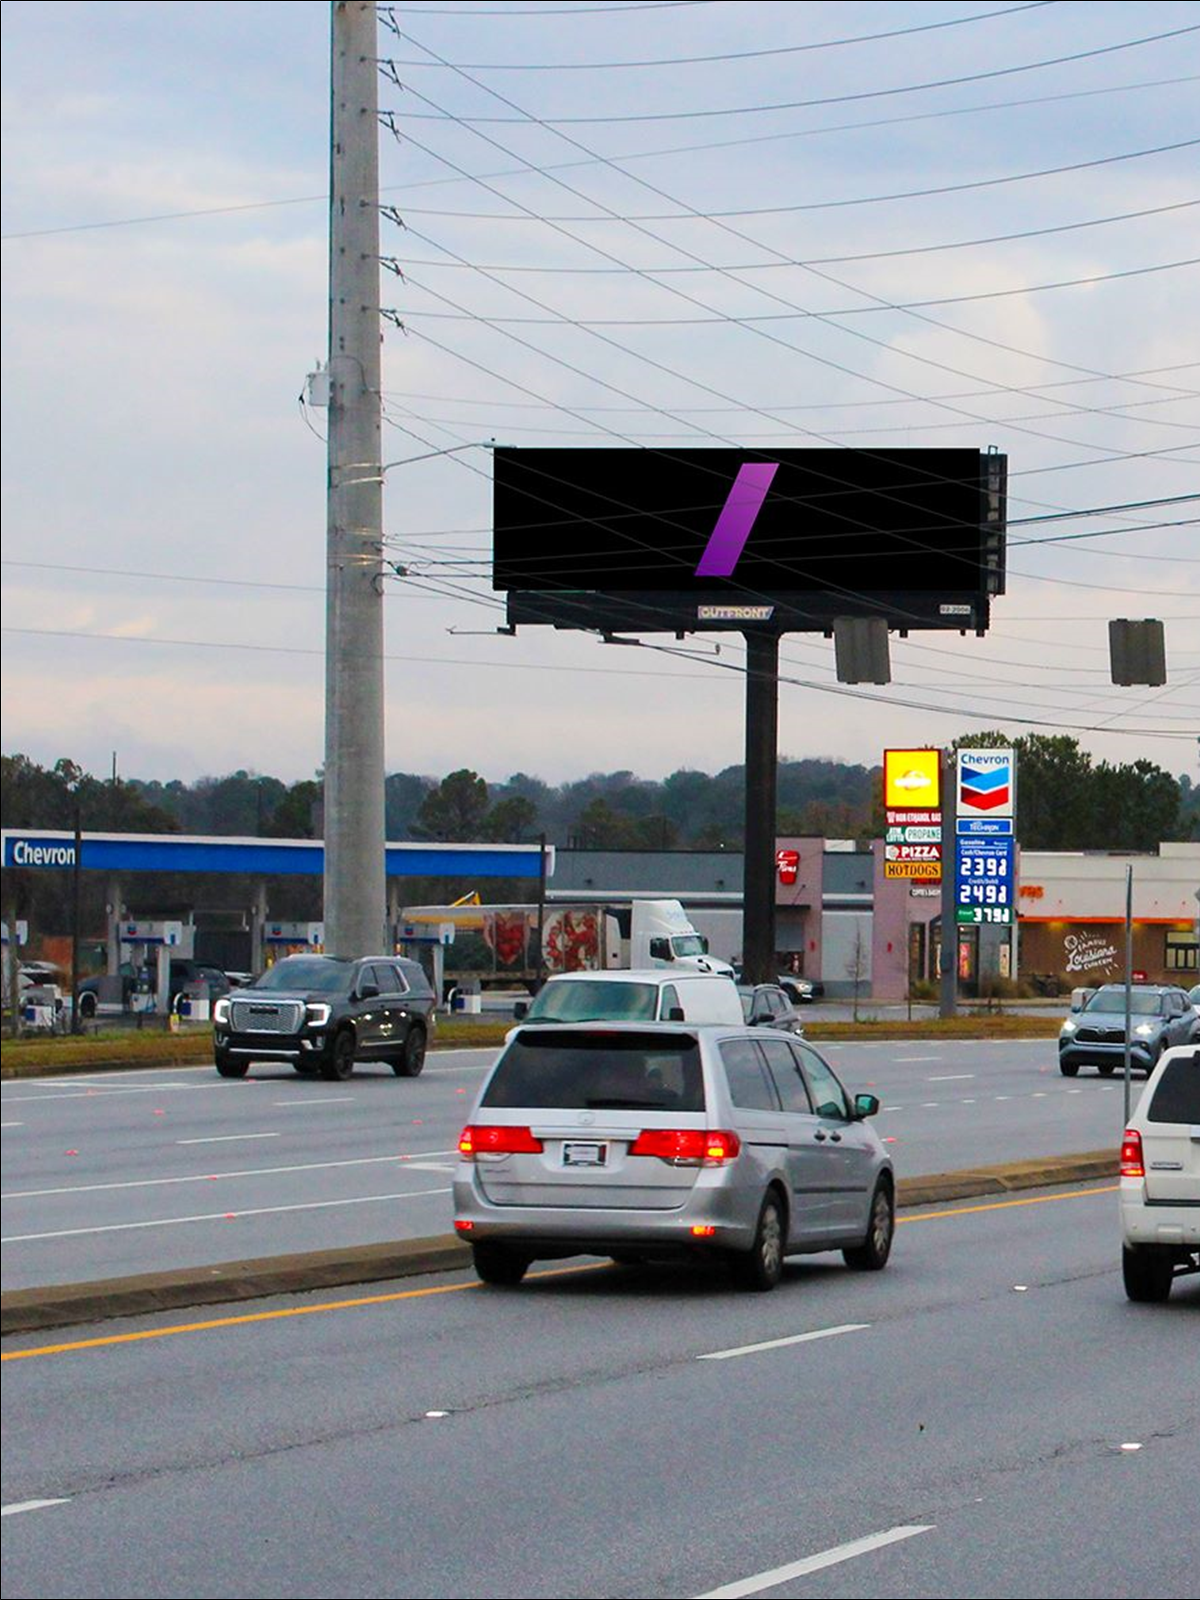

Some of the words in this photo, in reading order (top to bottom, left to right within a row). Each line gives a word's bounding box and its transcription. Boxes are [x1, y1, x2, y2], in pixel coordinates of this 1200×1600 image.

[701, 607, 769, 618] OUTFRONT
[961, 753, 1009, 764] Chevron
[908, 829, 941, 840] PROPANE
[14, 841, 76, 865] Chevron
[901, 846, 940, 858] PIZZA
